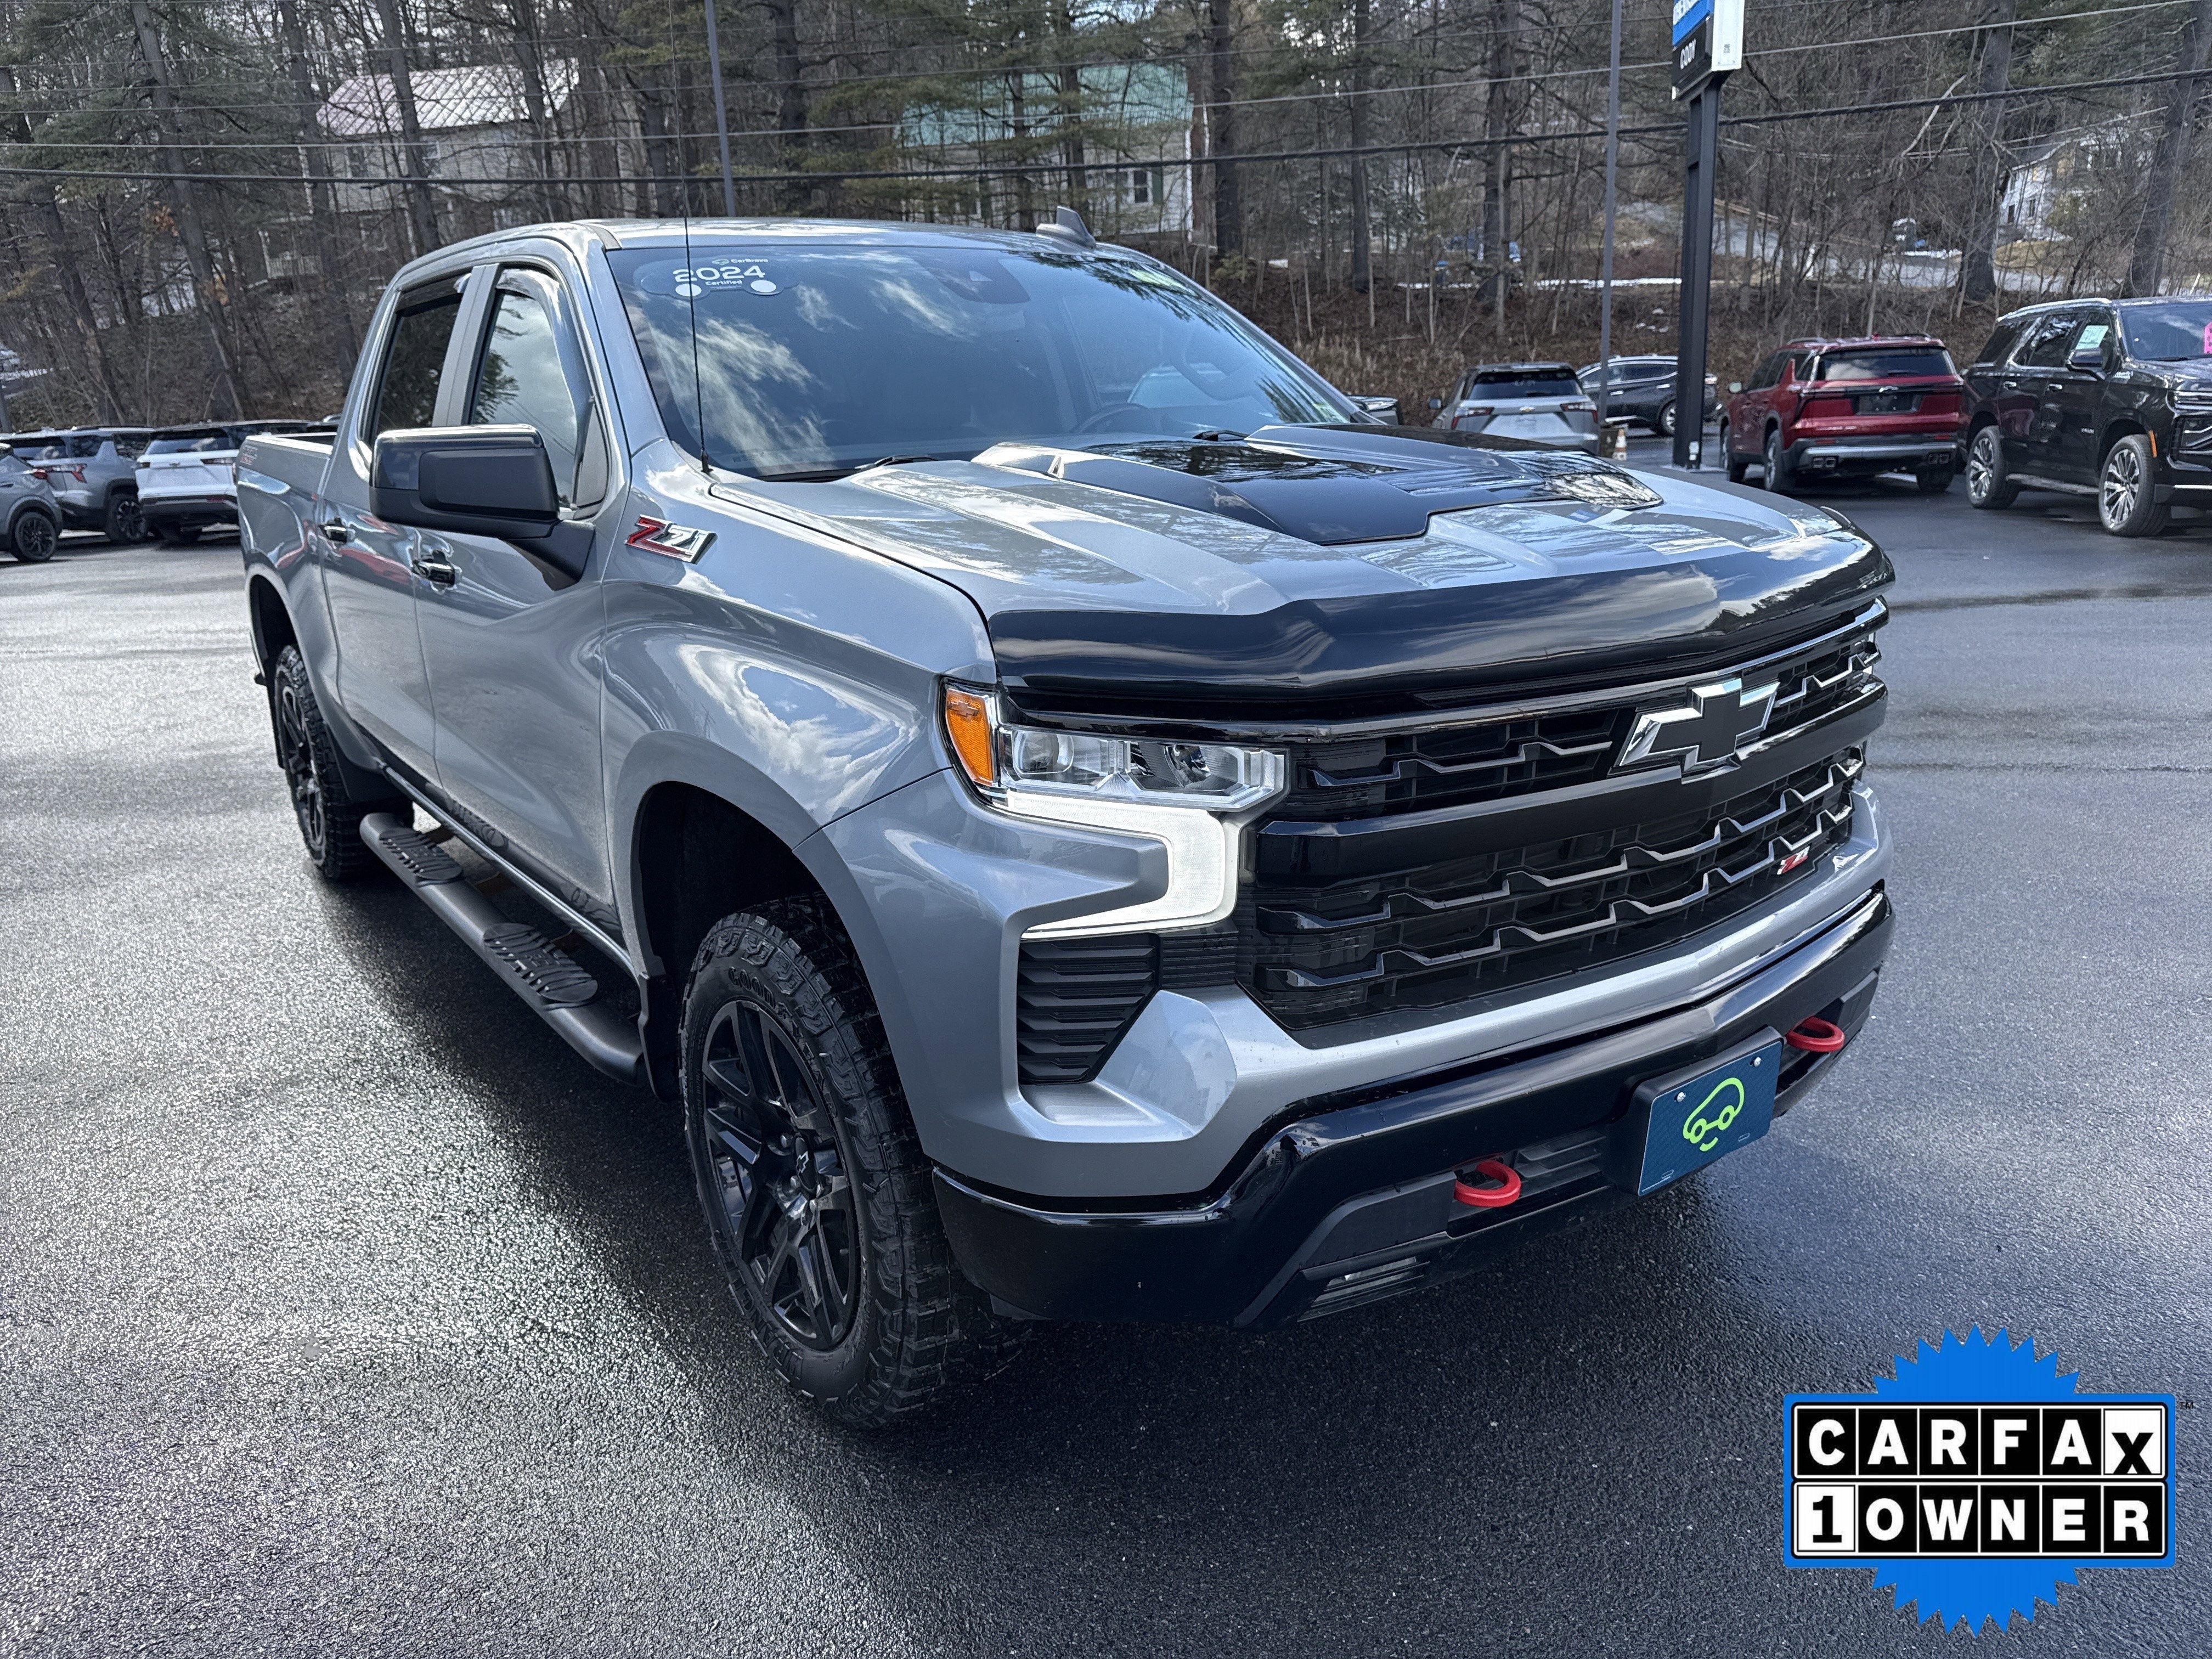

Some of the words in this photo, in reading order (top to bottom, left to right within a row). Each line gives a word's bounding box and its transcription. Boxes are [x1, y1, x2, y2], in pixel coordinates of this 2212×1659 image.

[673, 265, 766, 283] 2024
[624, 514, 718, 565] Z71
[713, 1228, 804, 1381] WRANGLER
